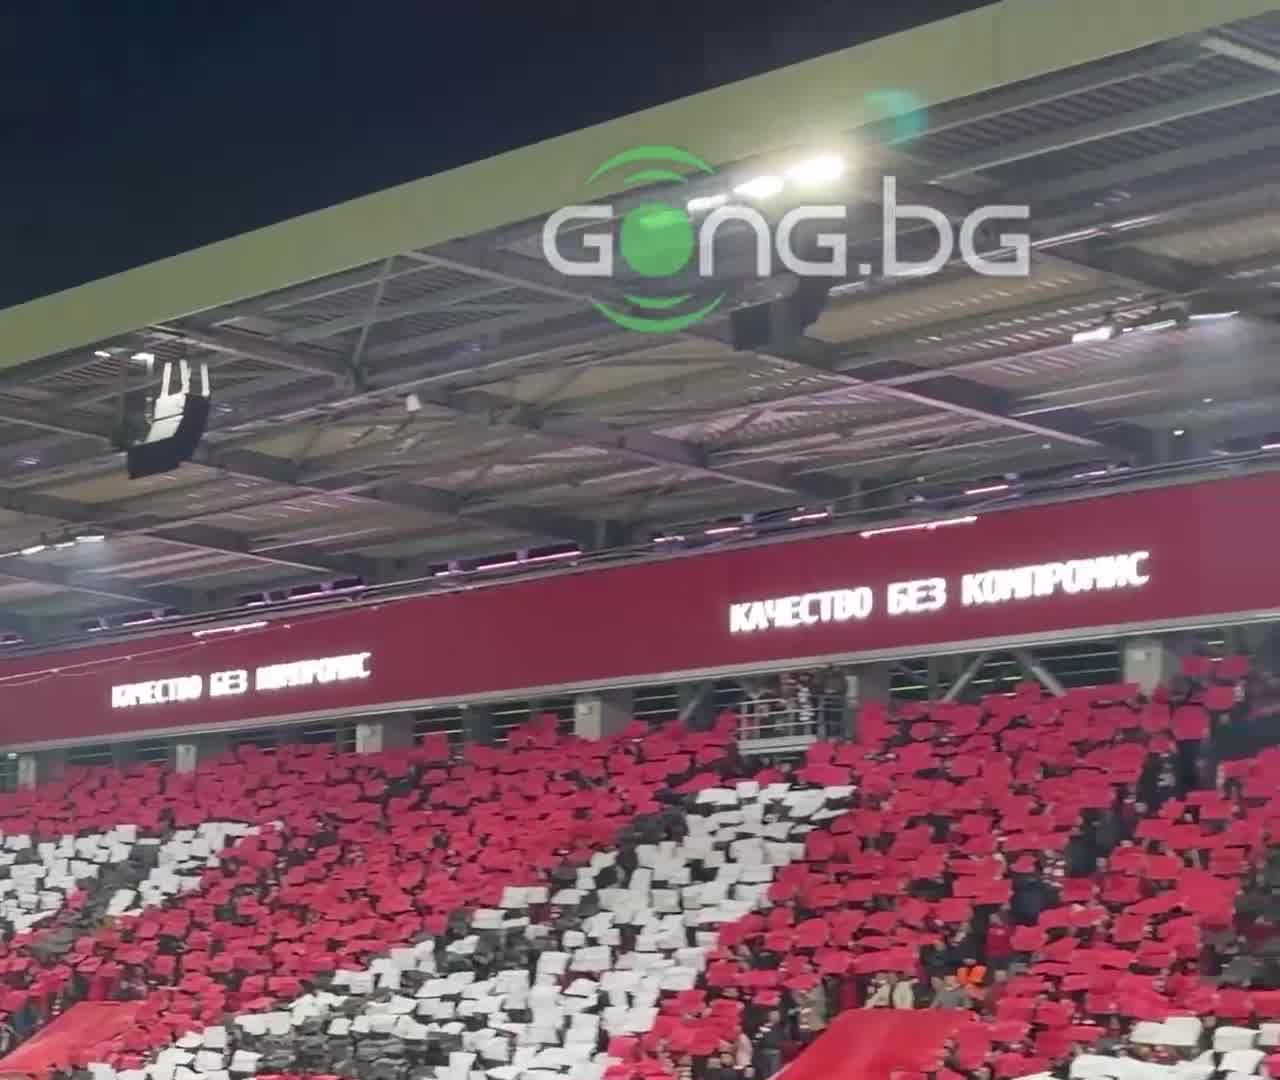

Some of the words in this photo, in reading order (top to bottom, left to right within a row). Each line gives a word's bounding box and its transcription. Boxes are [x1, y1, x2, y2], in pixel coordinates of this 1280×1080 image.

[729, 586, 873, 633] КАЧЕСТВО
[887, 577, 947, 615] БЕЗ
[961, 551, 1150, 607] КОМПРОМИС
